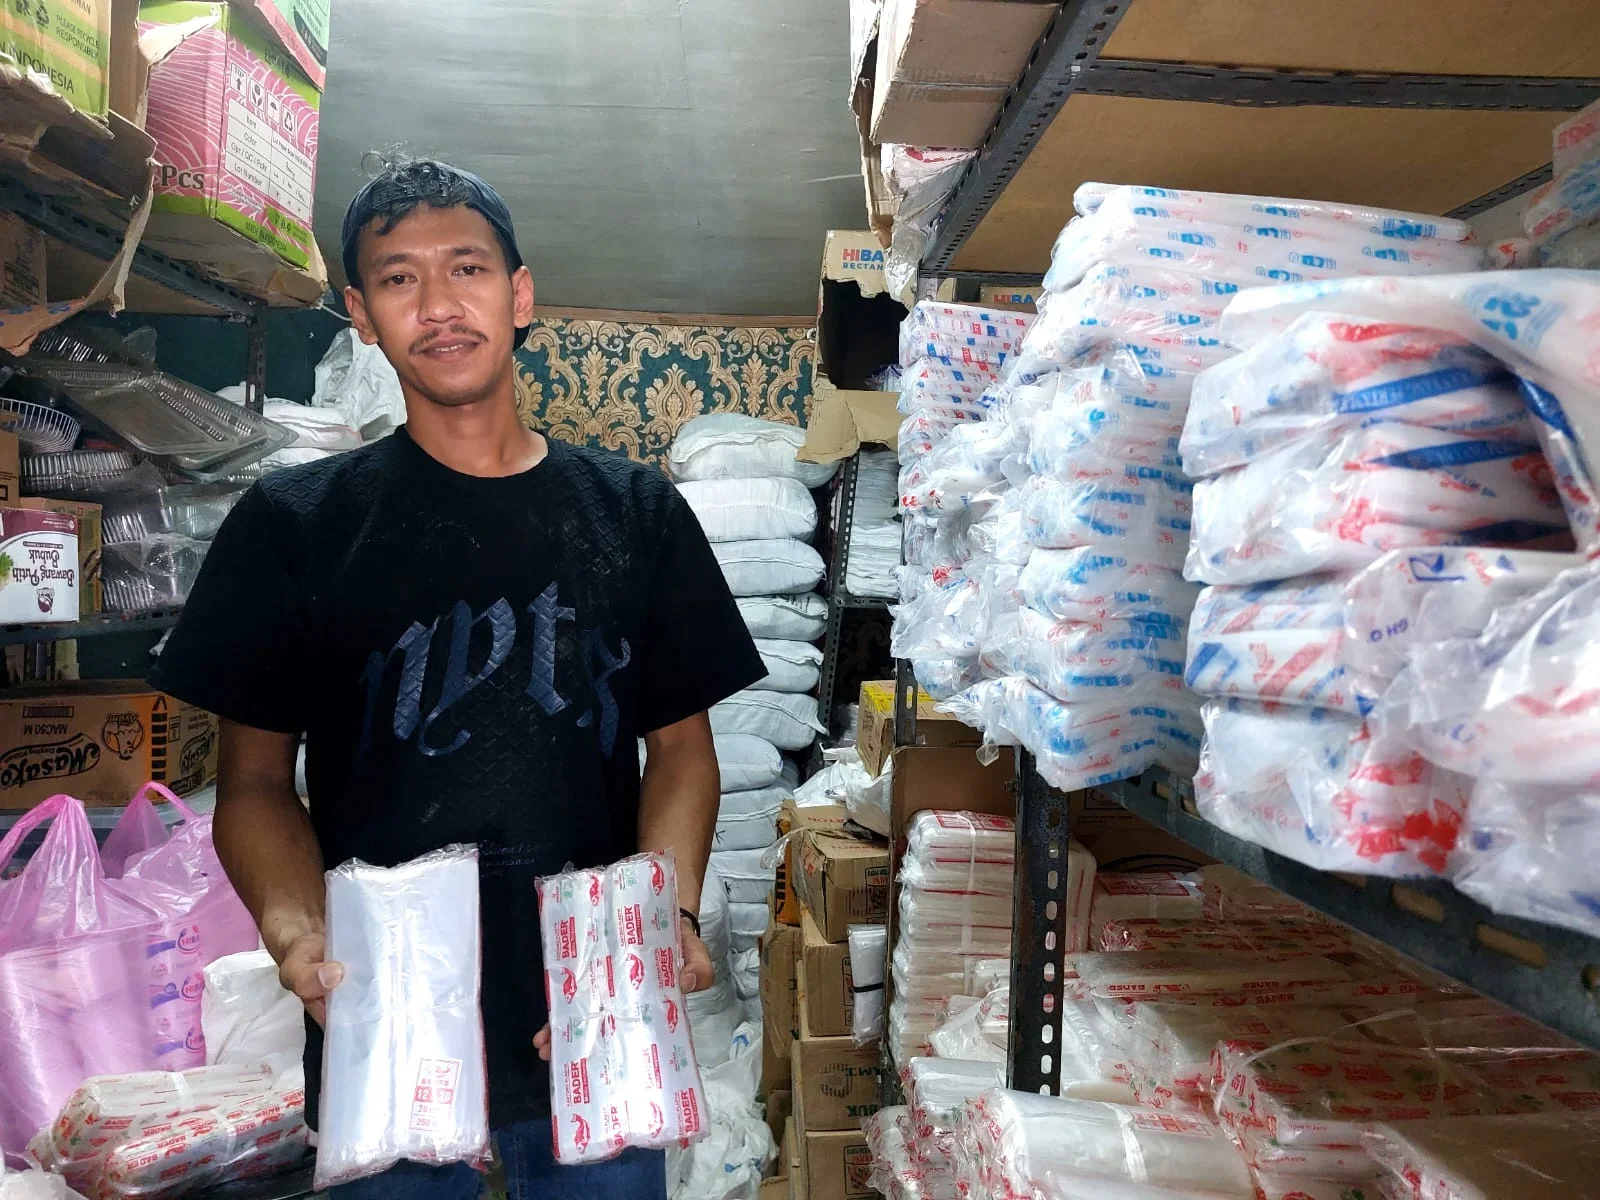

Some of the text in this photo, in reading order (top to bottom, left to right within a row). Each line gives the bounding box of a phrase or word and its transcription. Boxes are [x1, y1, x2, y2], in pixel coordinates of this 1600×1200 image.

[161, 165, 205, 190] Pcs
[843, 248, 884, 262] HIBA
[28, 549, 60, 569] Bubuk
[12, 564, 75, 588] Bawang Putih
[0, 742, 101, 788] Masako
[560, 920, 570, 958] BADER
[624, 905, 636, 945] BADER
[659, 948, 670, 987] BADER
[417, 1088, 430, 1099] 12
[571, 1061, 582, 1104] BADER
[680, 1090, 693, 1132] BADER
[127, 1153, 158, 1170] BADER
